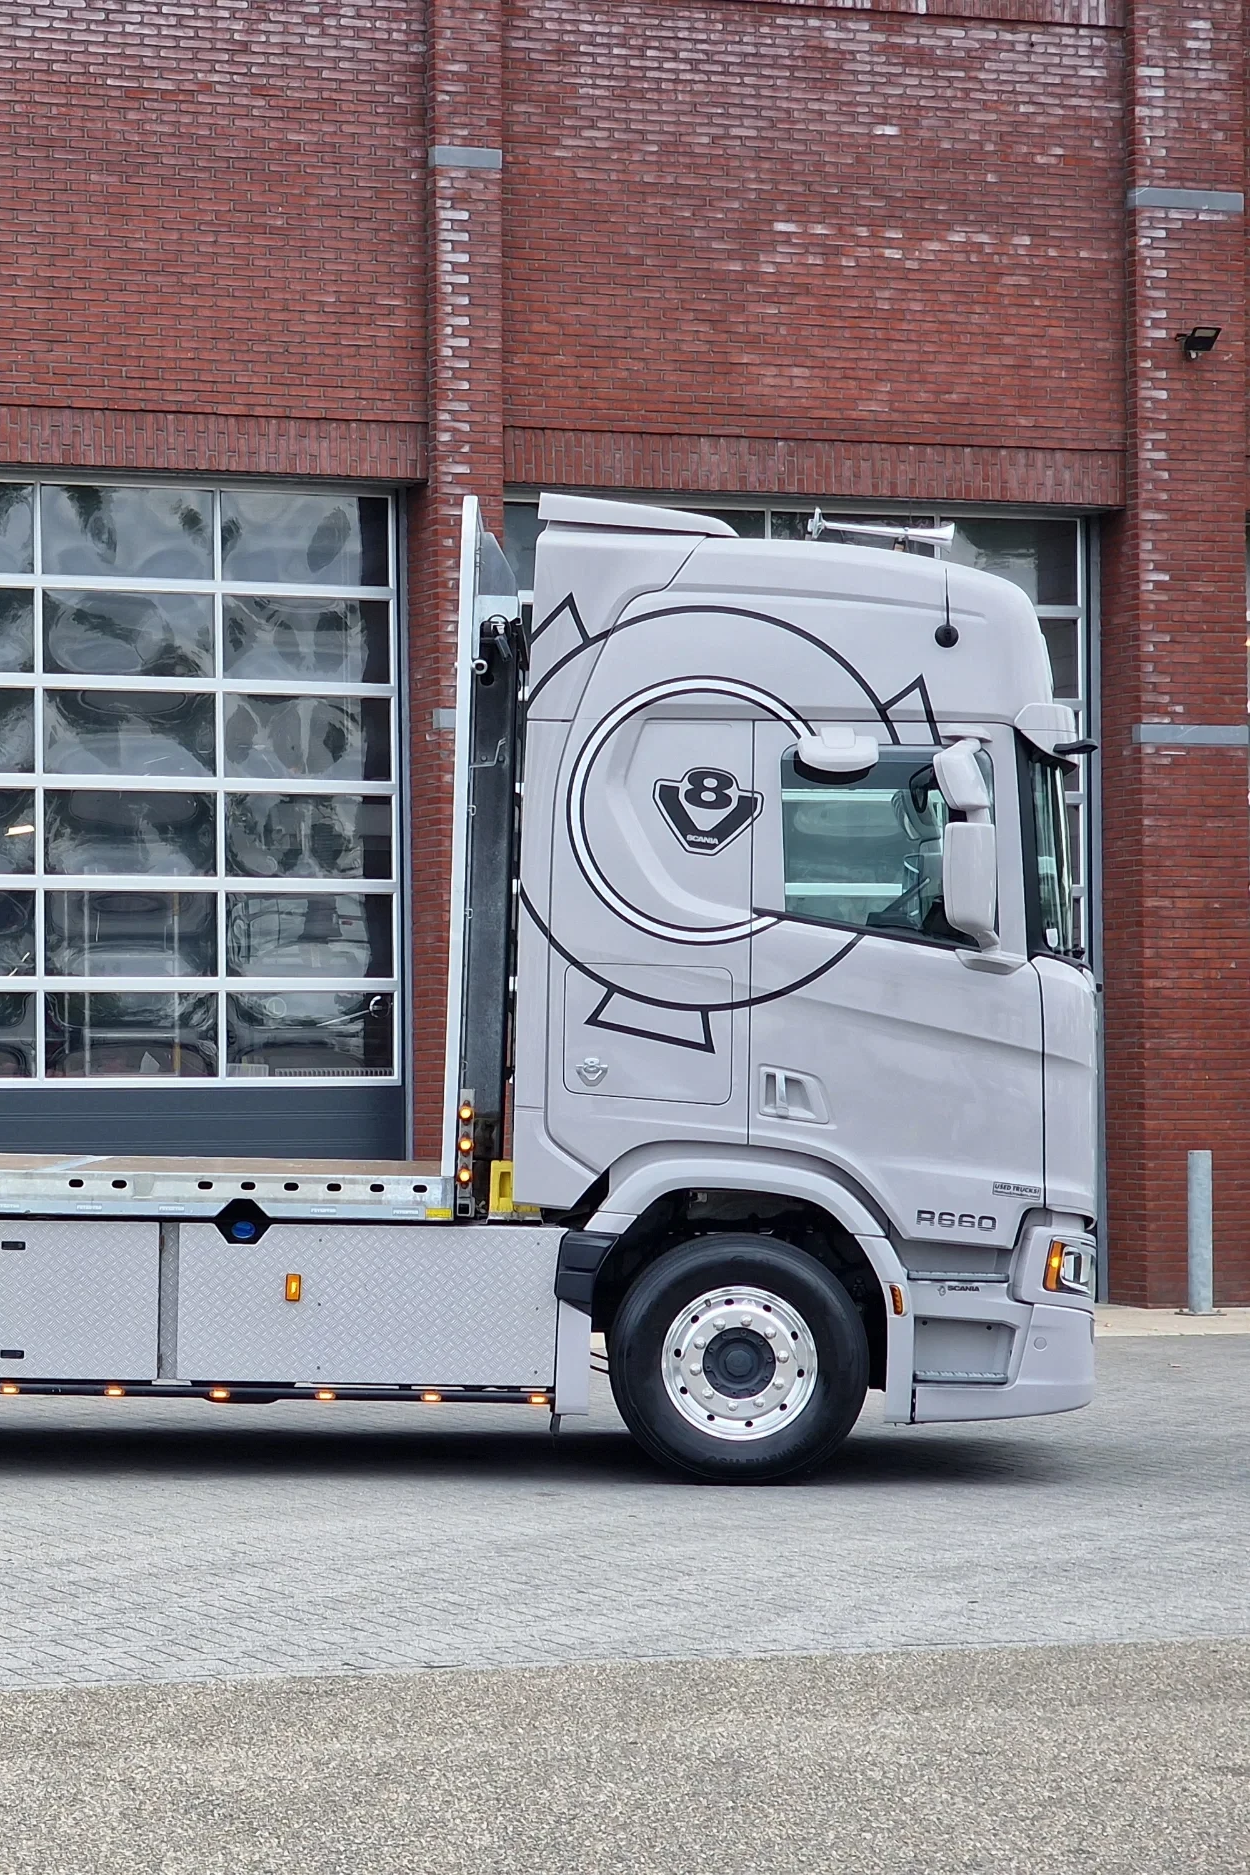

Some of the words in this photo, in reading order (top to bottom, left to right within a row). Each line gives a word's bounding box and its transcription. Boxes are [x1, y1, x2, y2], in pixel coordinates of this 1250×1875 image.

[686, 835, 719, 845] SCANIA
[994, 1183, 1012, 1191] USED
[916, 1210, 997, 1232] R660
